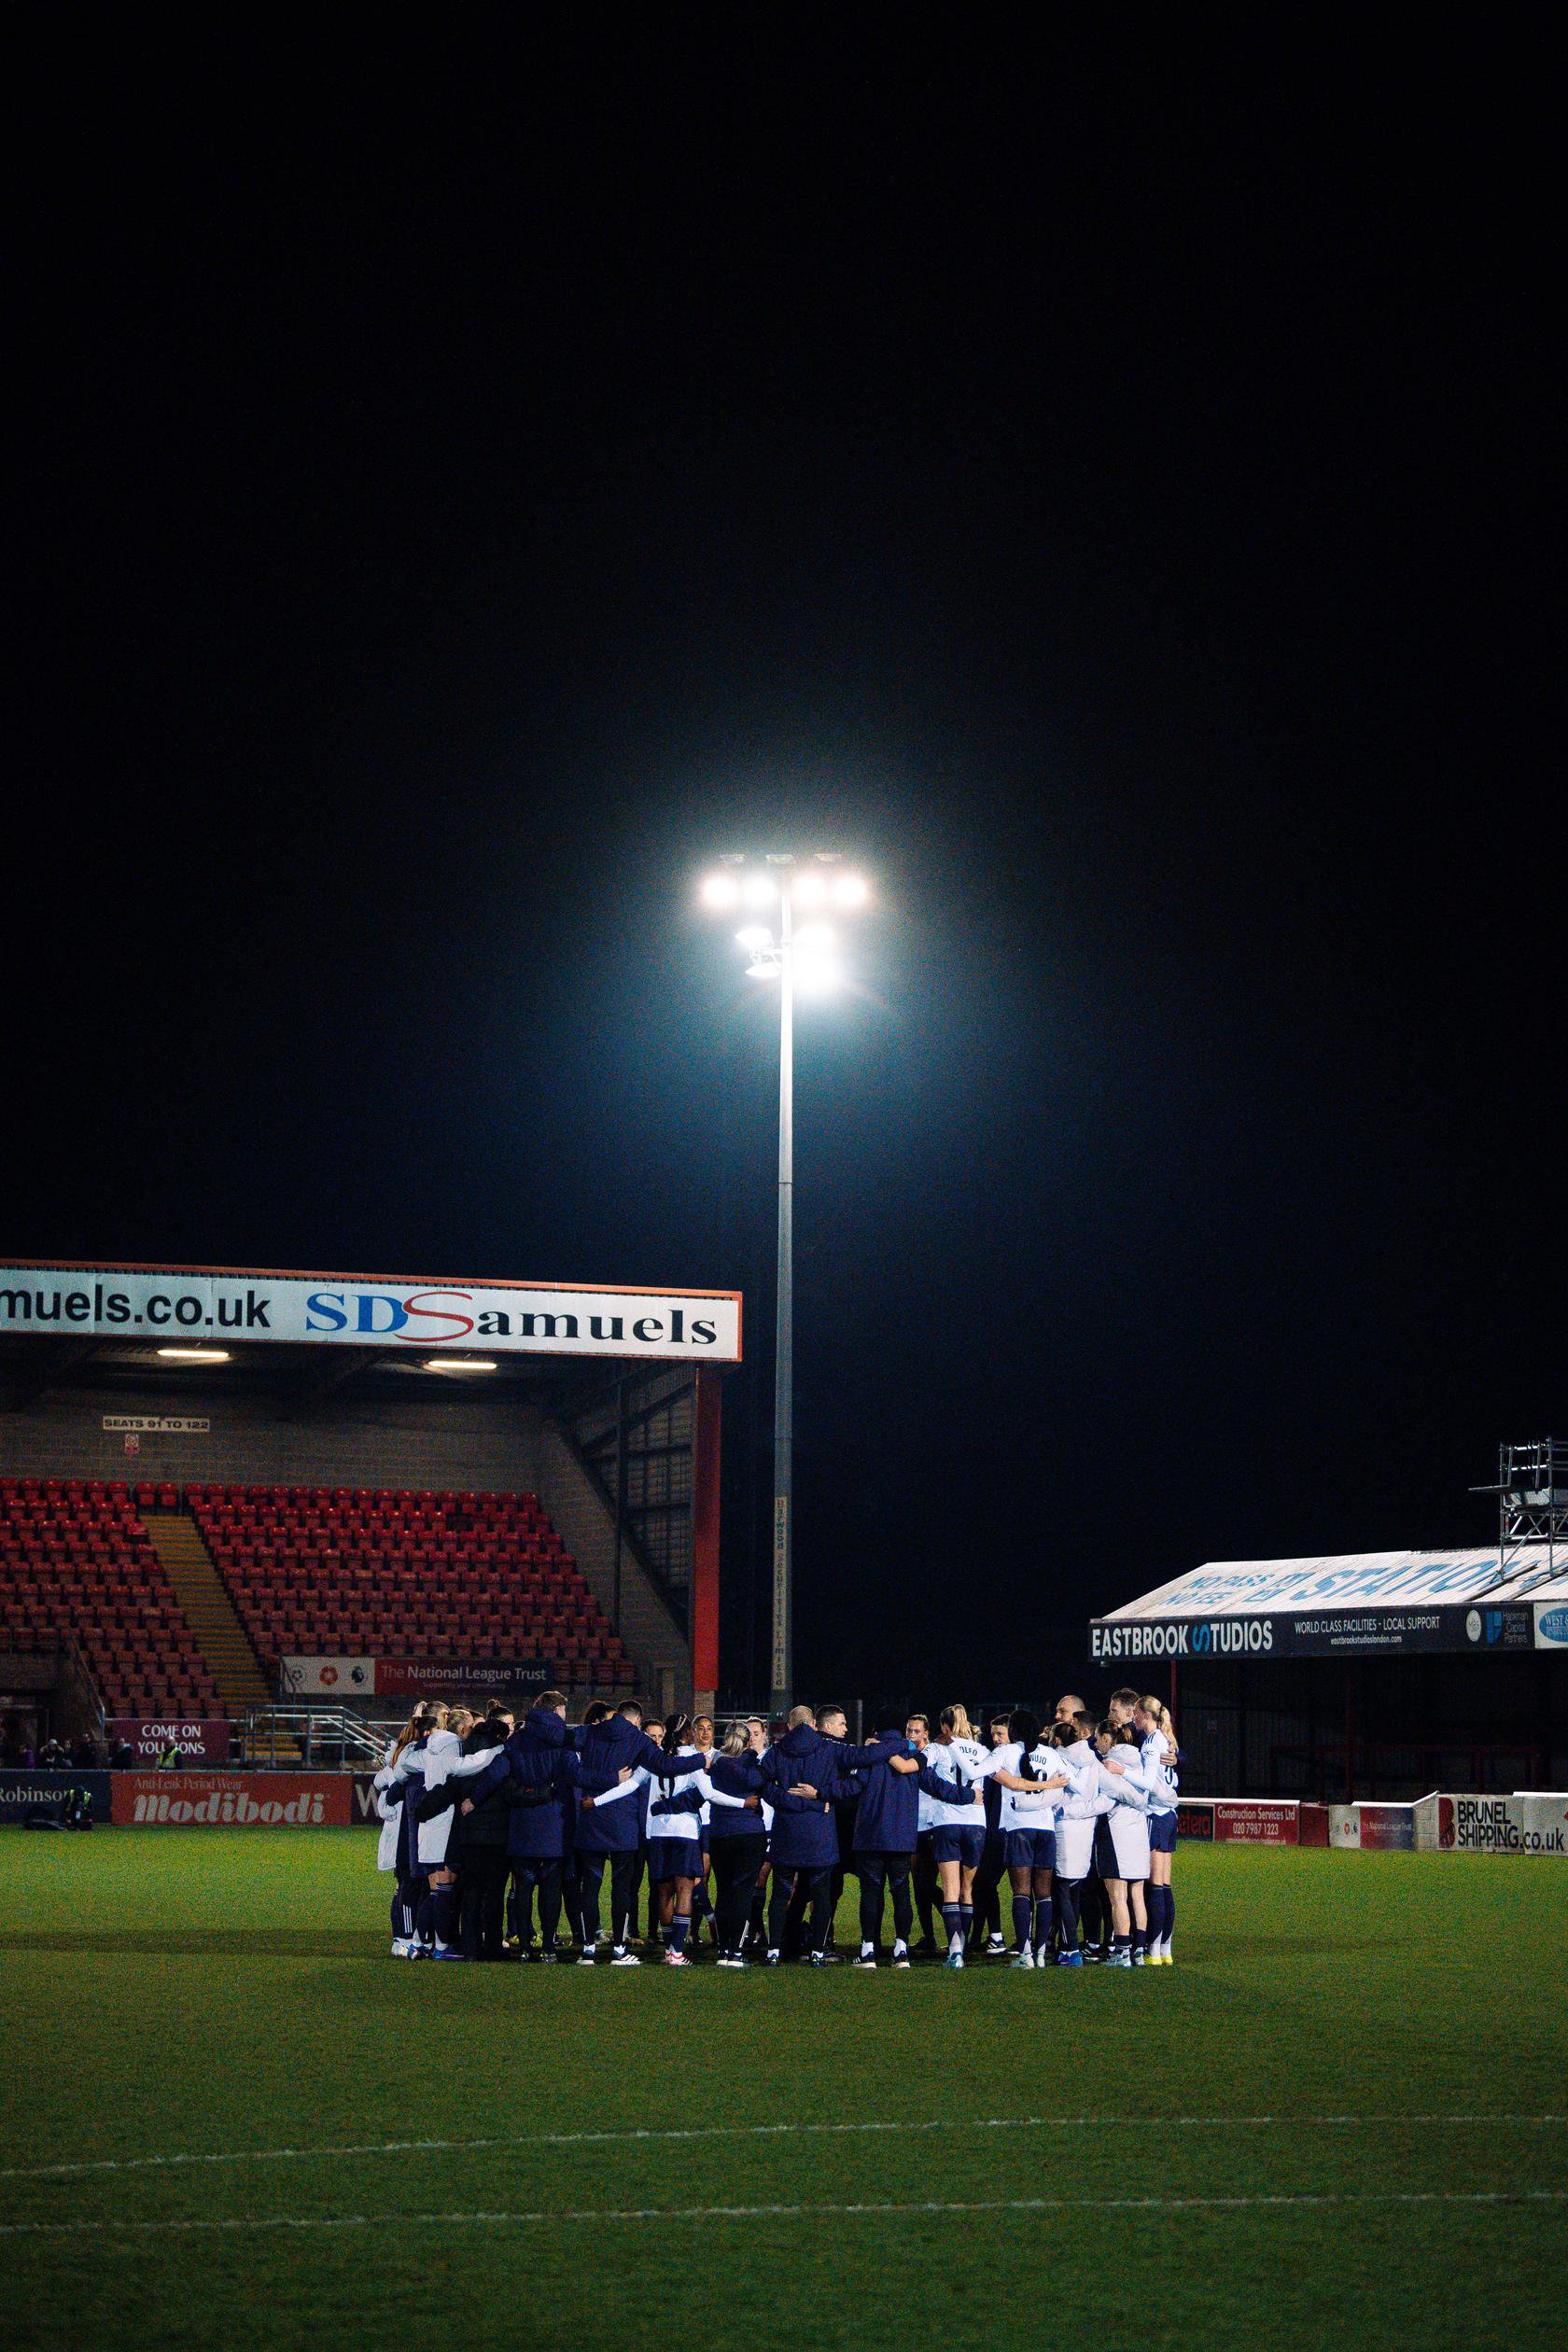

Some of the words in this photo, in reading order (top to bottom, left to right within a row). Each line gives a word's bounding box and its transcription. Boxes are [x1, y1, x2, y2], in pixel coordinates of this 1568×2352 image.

[0, 1284, 271, 1328] muels.co.uk
[105, 1420, 144, 1428] SEATS
[147, 1420, 161, 1428] 91
[165, 1421, 182, 1429] TO
[1295, 1621, 1319, 1633] WORLD
[1321, 1620, 1342, 1632] CLASS
[1343, 1618, 1377, 1631] FACILITIES
[1383, 1617, 1406, 1631] LOCAL
[1407, 1617, 1440, 1630] SUPPORT
[1092, 1625, 1188, 1657] EASTBROOK
[1193, 1620, 1272, 1652] STUDIOS
[382, 1665, 404, 1678] The
[407, 1666, 462, 1679] National
[466, 1667, 511, 1682] League
[514, 1668, 547, 1680] Trust
[142, 1725, 179, 1738] COME
[182, 1725, 201, 1737] ON
[137, 1742, 164, 1754] YOU
[175, 1742, 205, 1754] ONS
[133, 1792, 325, 1822] Modibodi
[1218, 1806, 1255, 1819] Construction
[1257, 1808, 1284, 1820] Services
[1285, 1807, 1295, 1820] Ltd
[1457, 1801, 1512, 1825] BRUNEL
[1233, 1822, 1245, 1834] 020
[1264, 1823, 1279, 1835] 1223
